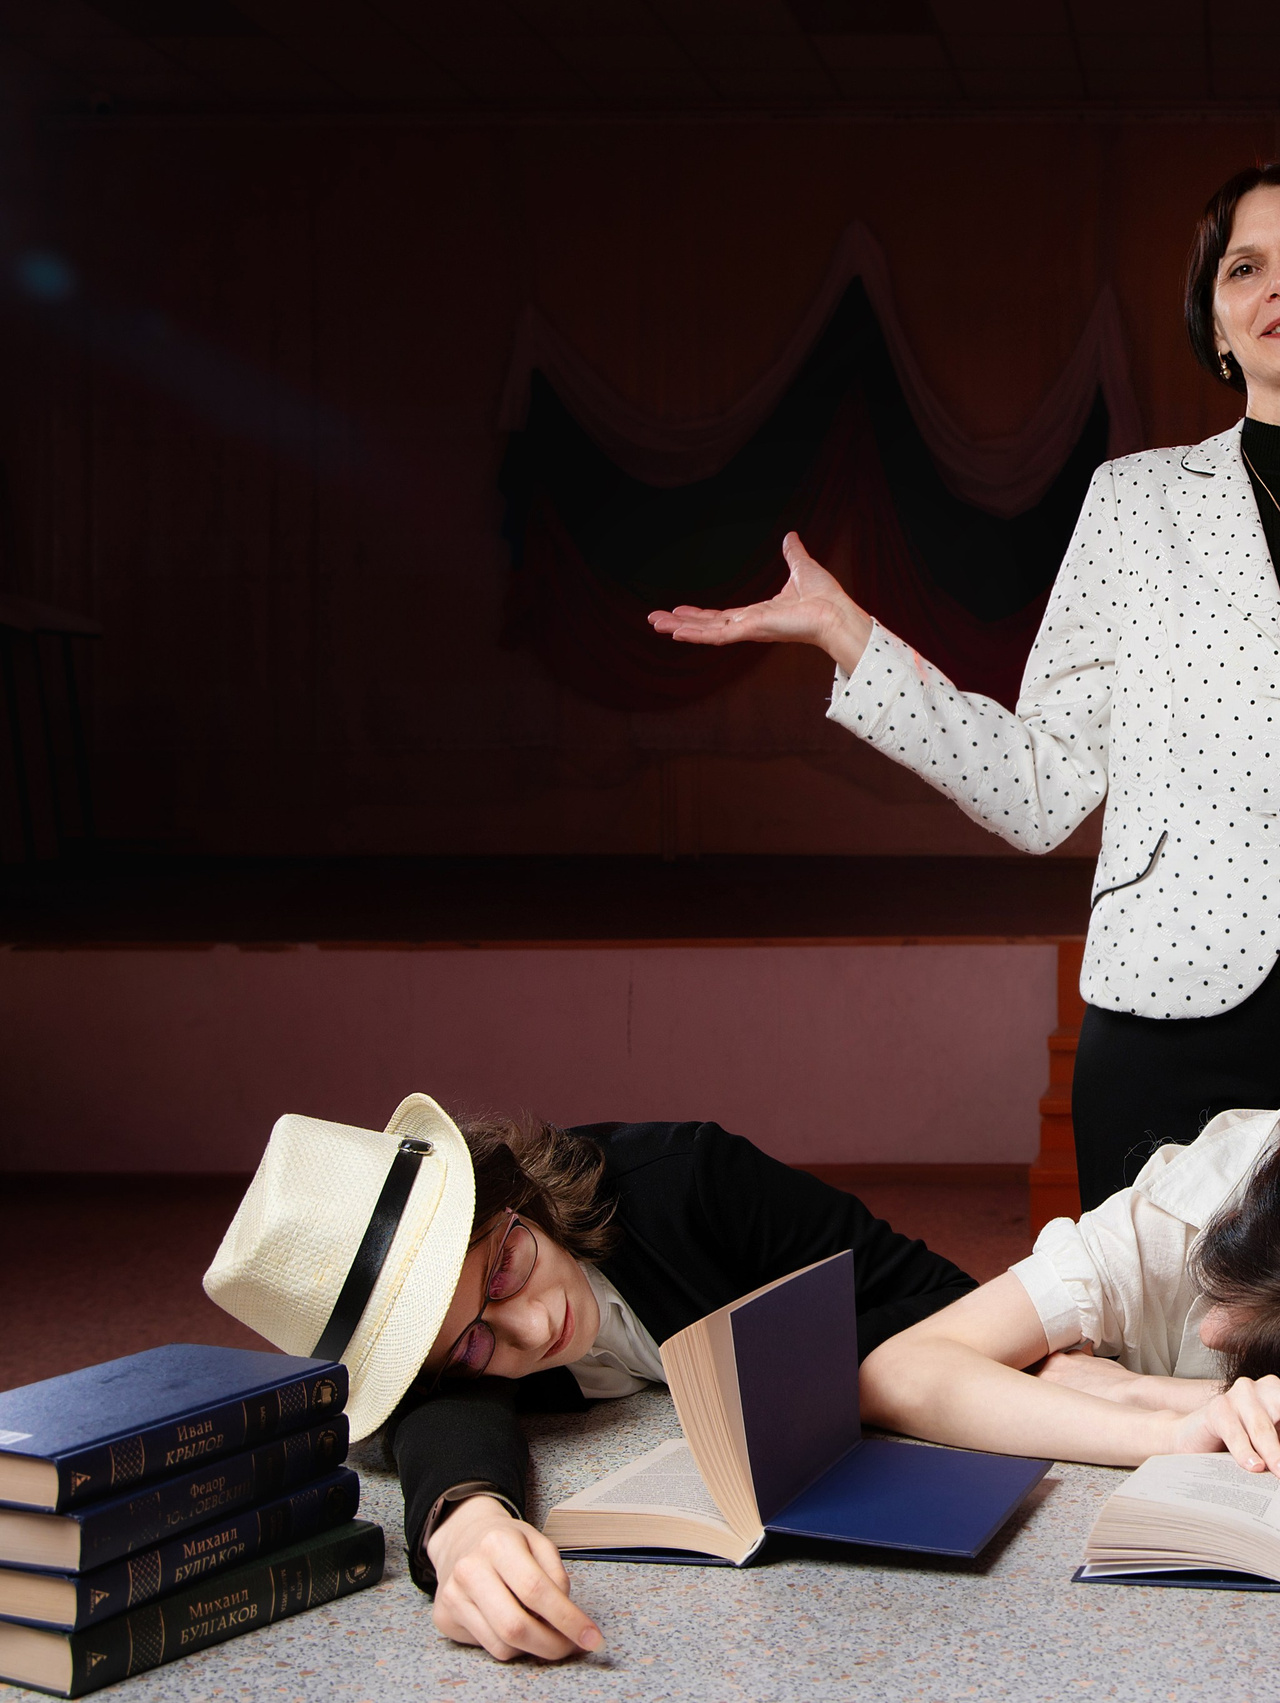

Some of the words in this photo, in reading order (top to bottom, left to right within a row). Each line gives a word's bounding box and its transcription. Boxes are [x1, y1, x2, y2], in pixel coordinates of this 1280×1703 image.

[176, 1420, 213, 1442] Иван
[165, 1433, 225, 1467] КРЫЛОВ
[164, 1479, 252, 1529] ООЕВСКИЙ
[190, 1476, 226, 1499] Федор
[182, 1527, 238, 1560] Михаил
[174, 1542, 246, 1584] БУЛГАКОВ
[188, 1588, 249, 1621] Михаил
[180, 1603, 258, 1645] БУЛГАКОВ
